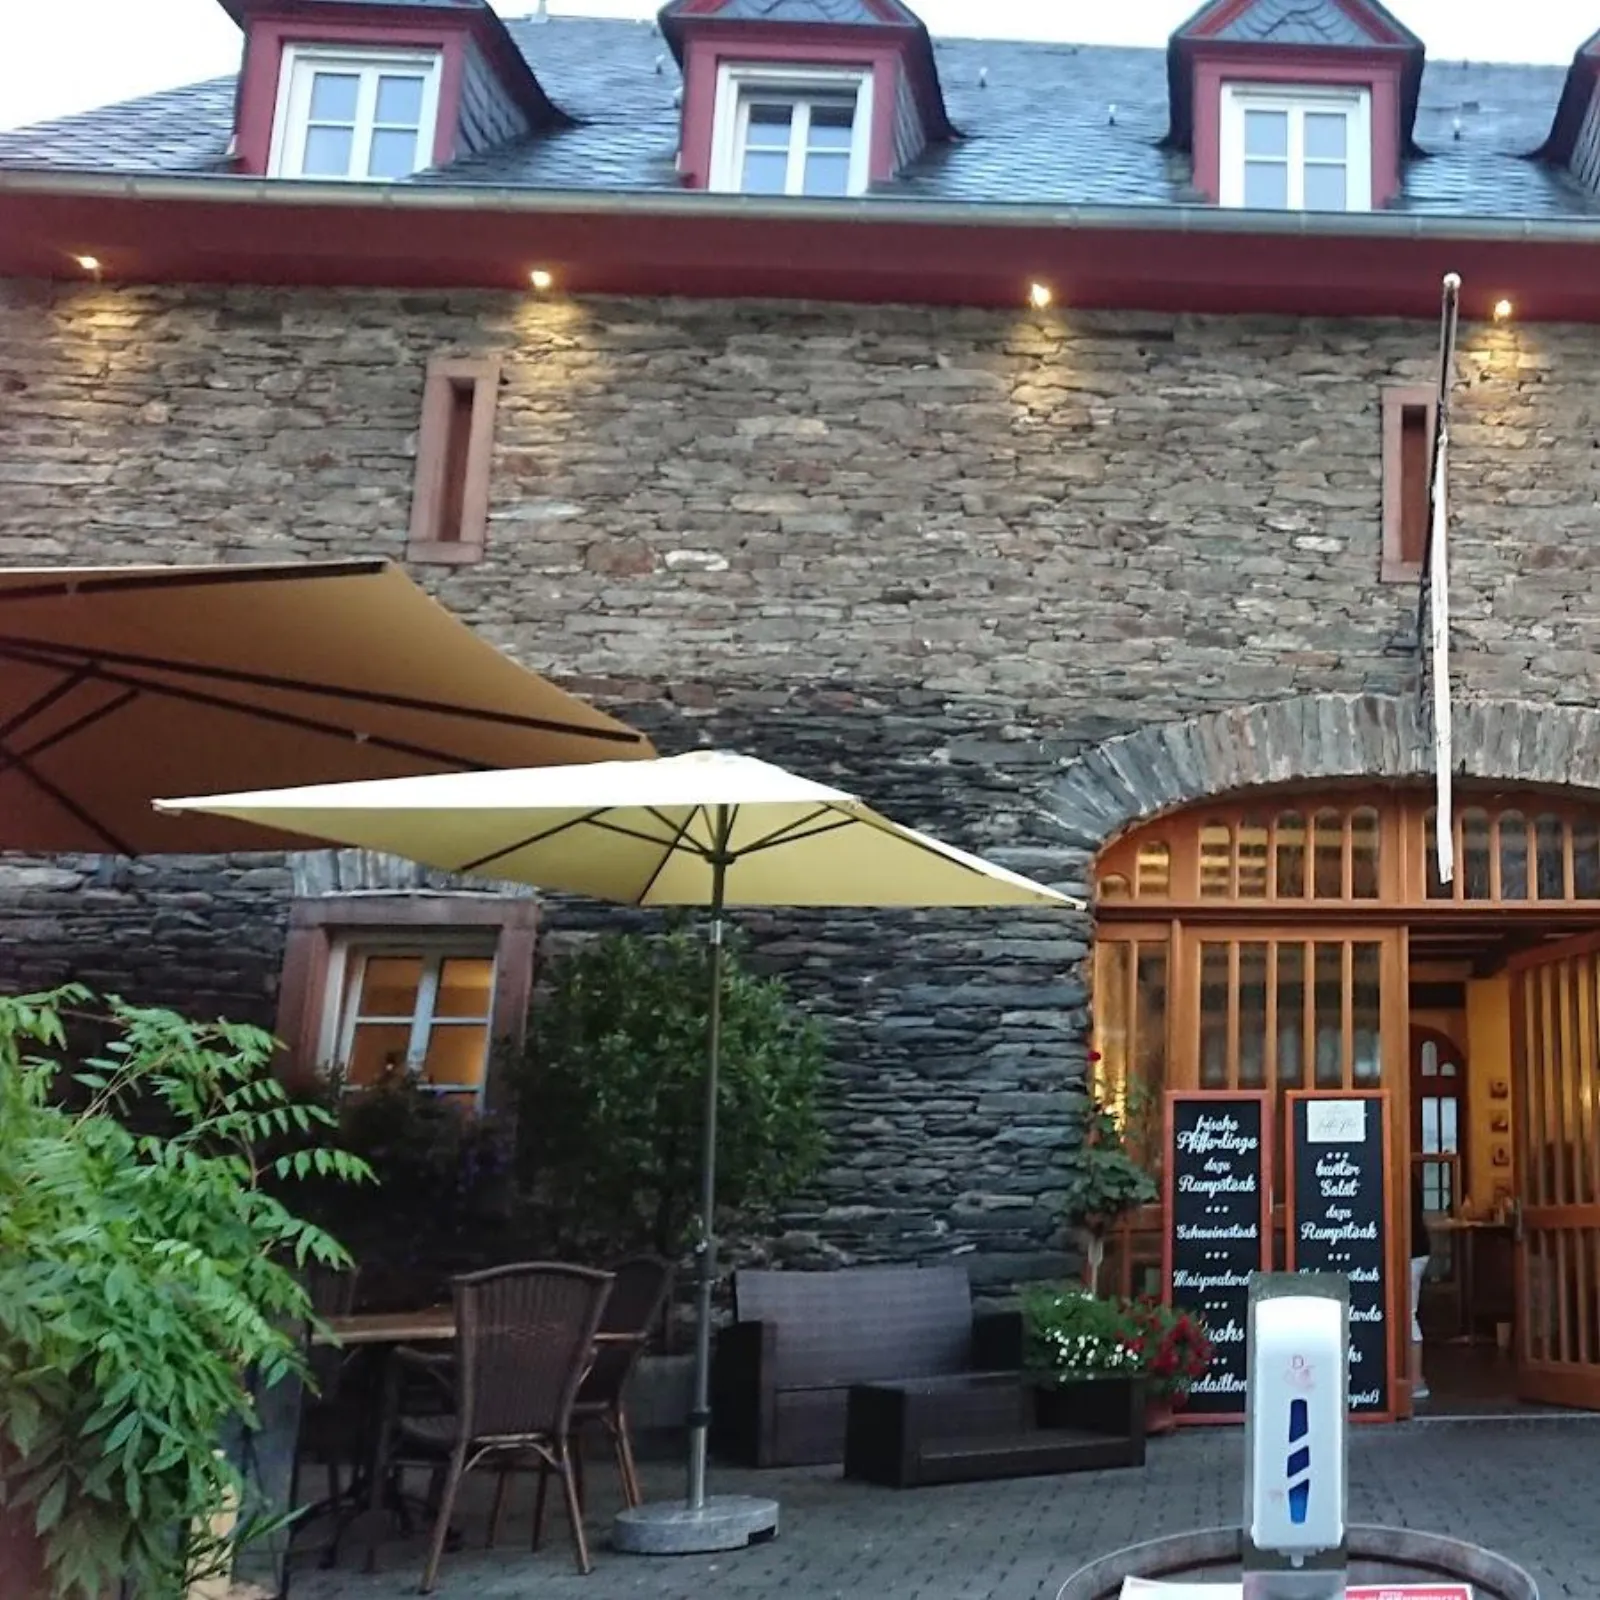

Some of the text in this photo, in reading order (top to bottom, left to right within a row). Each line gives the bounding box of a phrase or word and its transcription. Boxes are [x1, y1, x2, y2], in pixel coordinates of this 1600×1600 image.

[1315, 1158, 1361, 1177] bunter
[1178, 1173, 1256, 1199] Rumpsteak
[1320, 1179, 1361, 1197] Salat
[1300, 1220, 1379, 1246] Rumpsteak
[1173, 1269, 1253, 1293] Maispoulard
